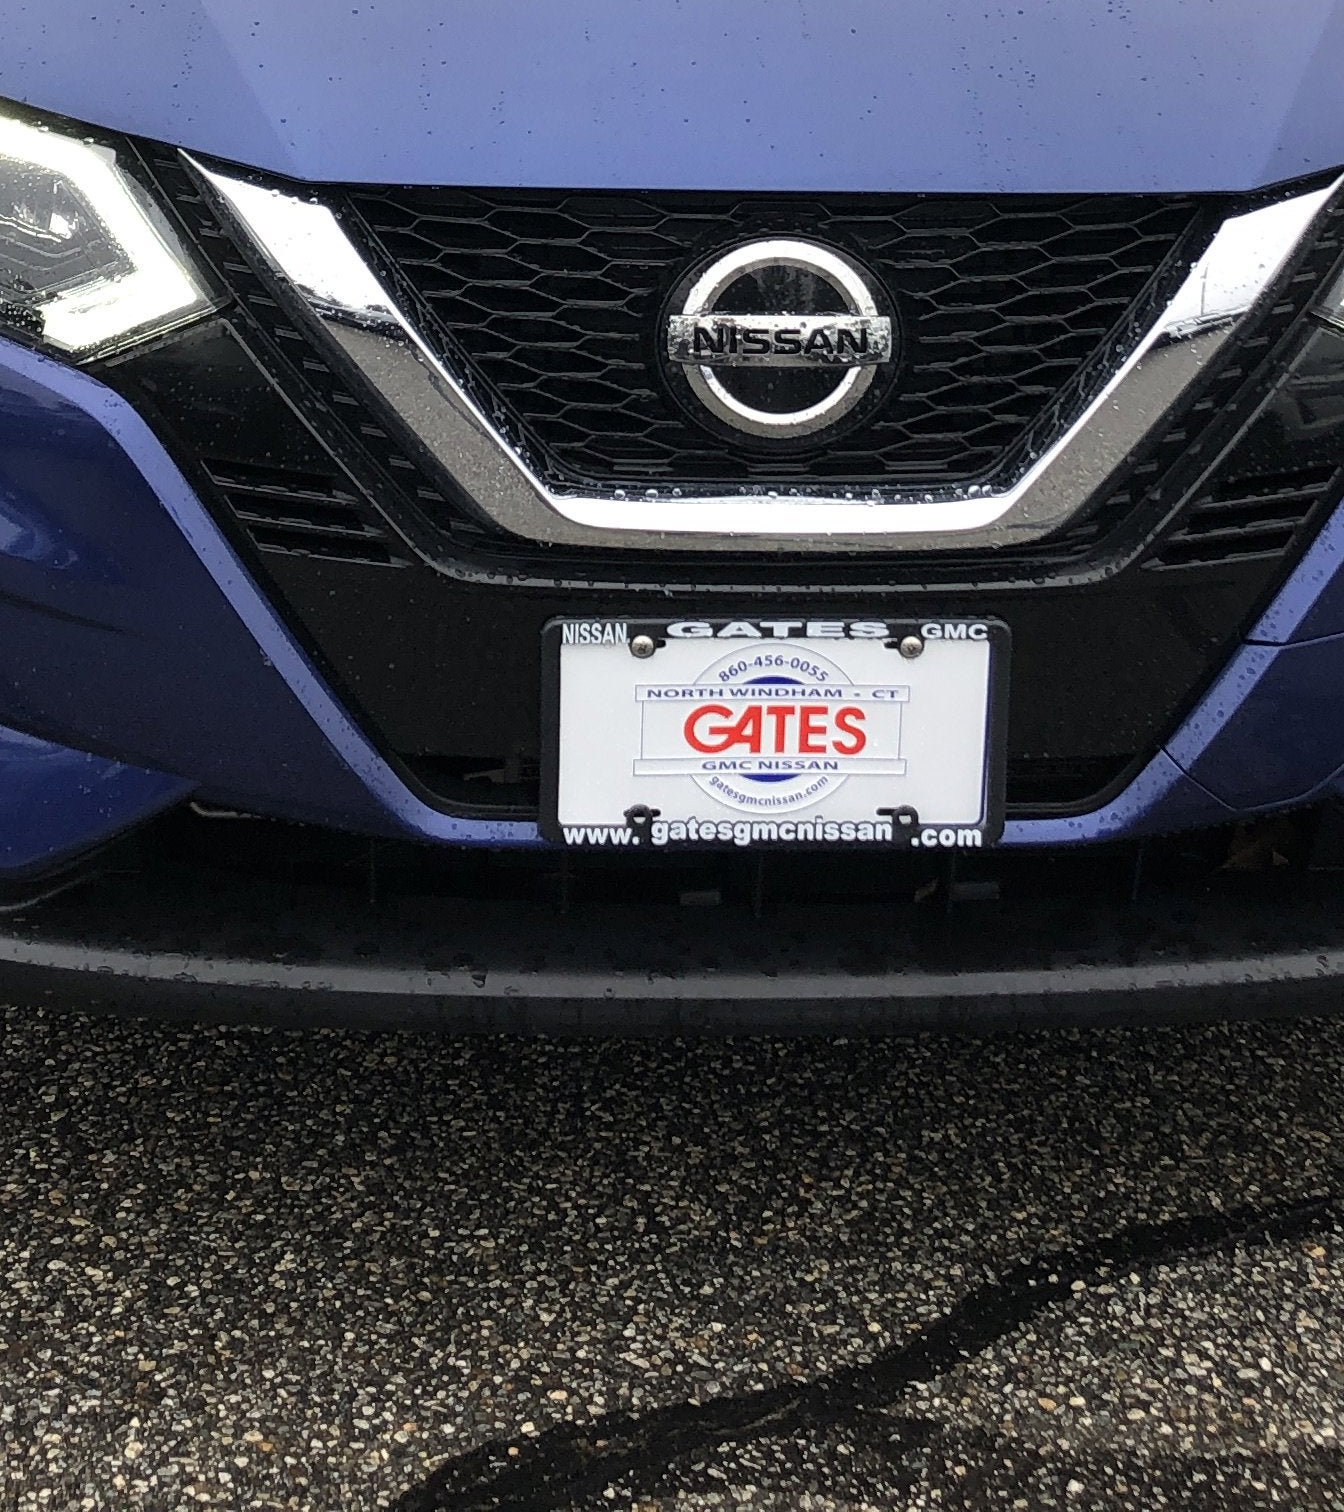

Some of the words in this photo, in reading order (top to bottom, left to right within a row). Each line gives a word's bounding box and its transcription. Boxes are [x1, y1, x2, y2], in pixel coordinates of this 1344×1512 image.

[693, 326, 867, 356] NISSAN
[562, 622, 628, 645] NISSAN
[667, 621, 890, 639] GATES
[920, 623, 988, 640] GMC
[718, 654, 829, 683] 860-456-0055
[646, 688, 723, 698] NORTH
[729, 688, 843, 699] WINDHAM
[872, 689, 899, 699] CT
[684, 704, 867, 756] GATES
[702, 760, 752, 770] GMC
[758, 760, 839, 771] NISSAN
[709, 774, 829, 807] gatesgmcnissan.com
[651, 816, 892, 846] gatesgmcnissan
